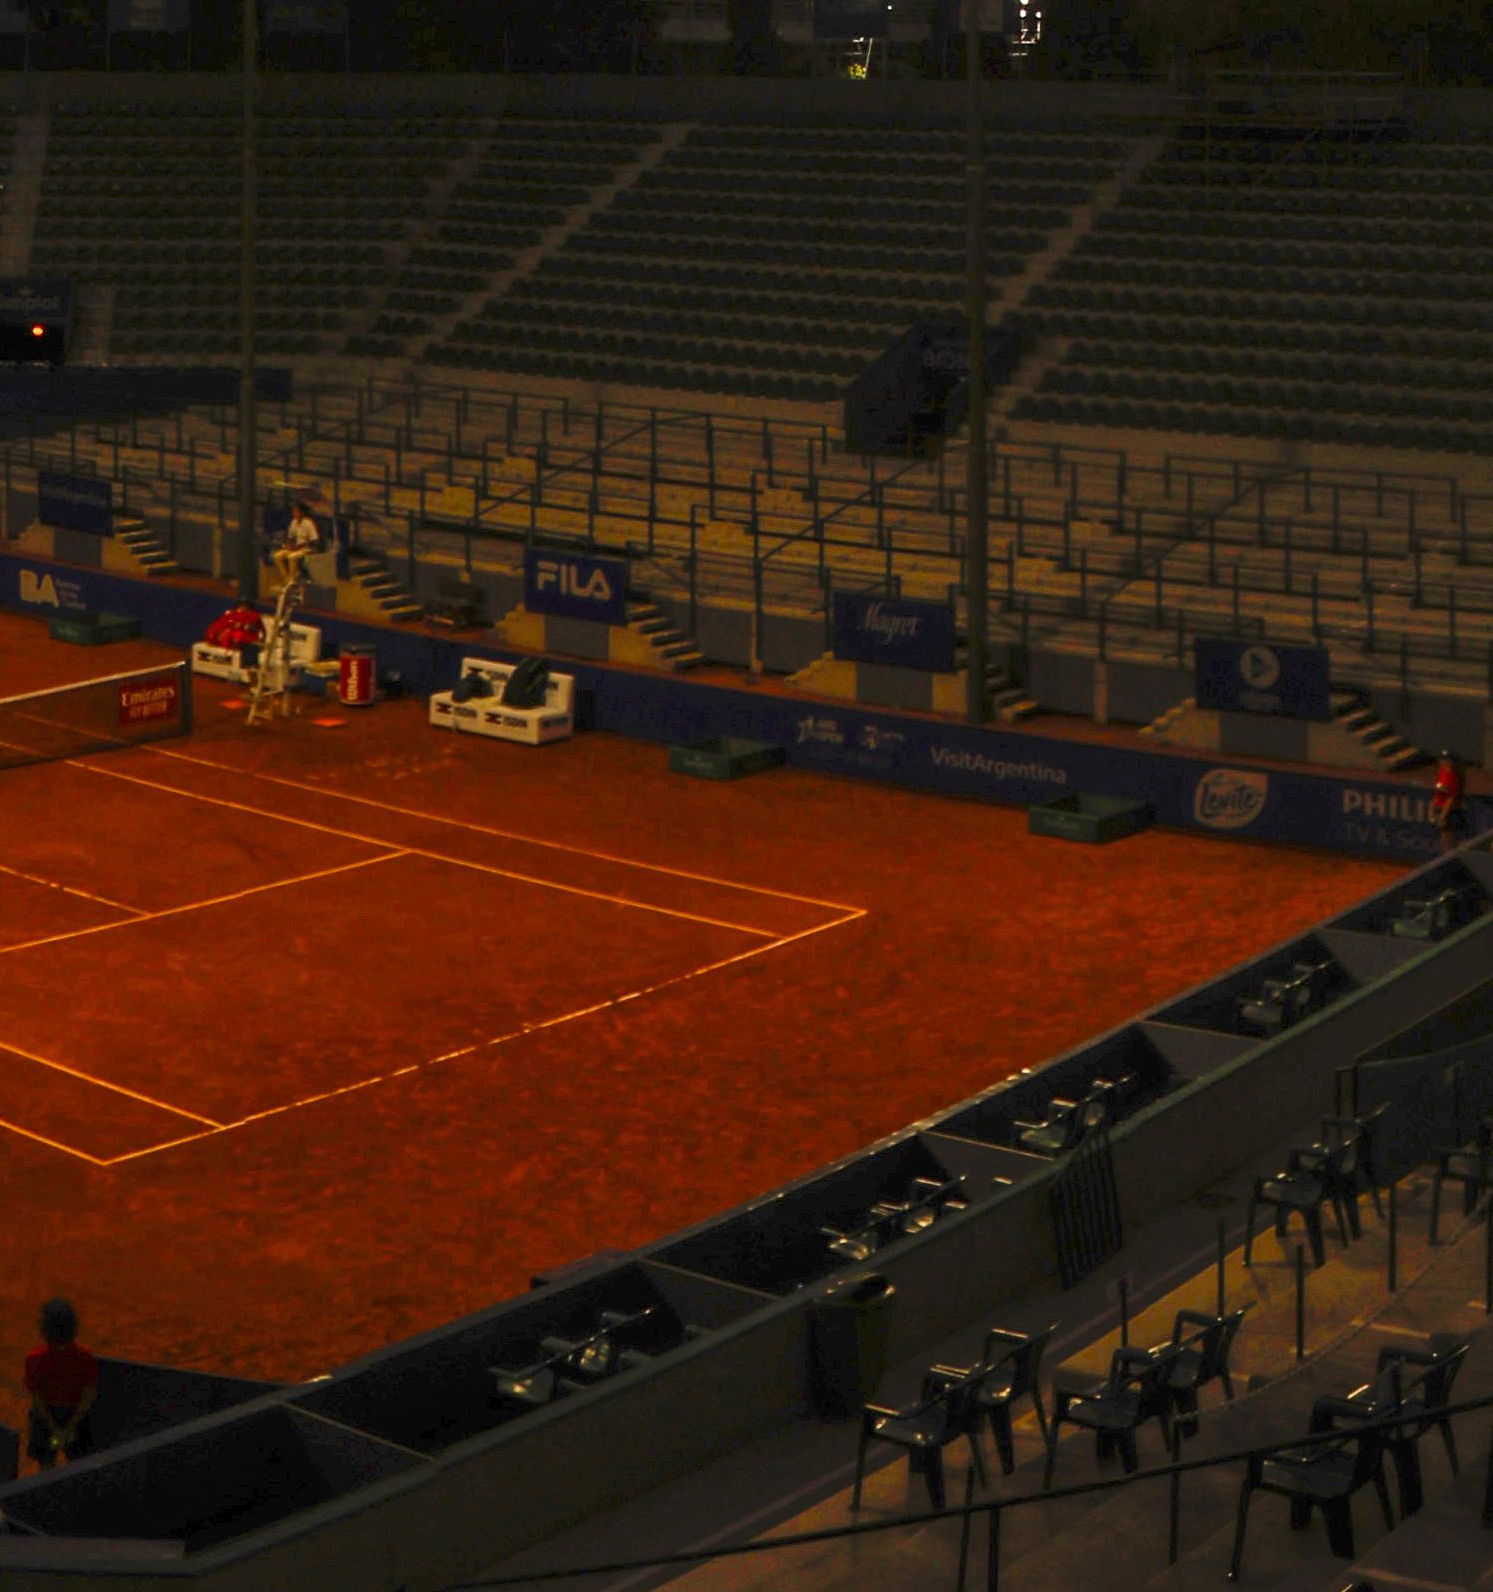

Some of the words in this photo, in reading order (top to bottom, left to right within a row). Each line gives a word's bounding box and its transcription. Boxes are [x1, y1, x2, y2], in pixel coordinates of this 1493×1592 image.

[536, 559, 612, 601] FILA
[122, 687, 175, 707] Emirates
[929, 744, 1068, 784] VisitArgentina
[1343, 789, 1440, 824] PHILI
